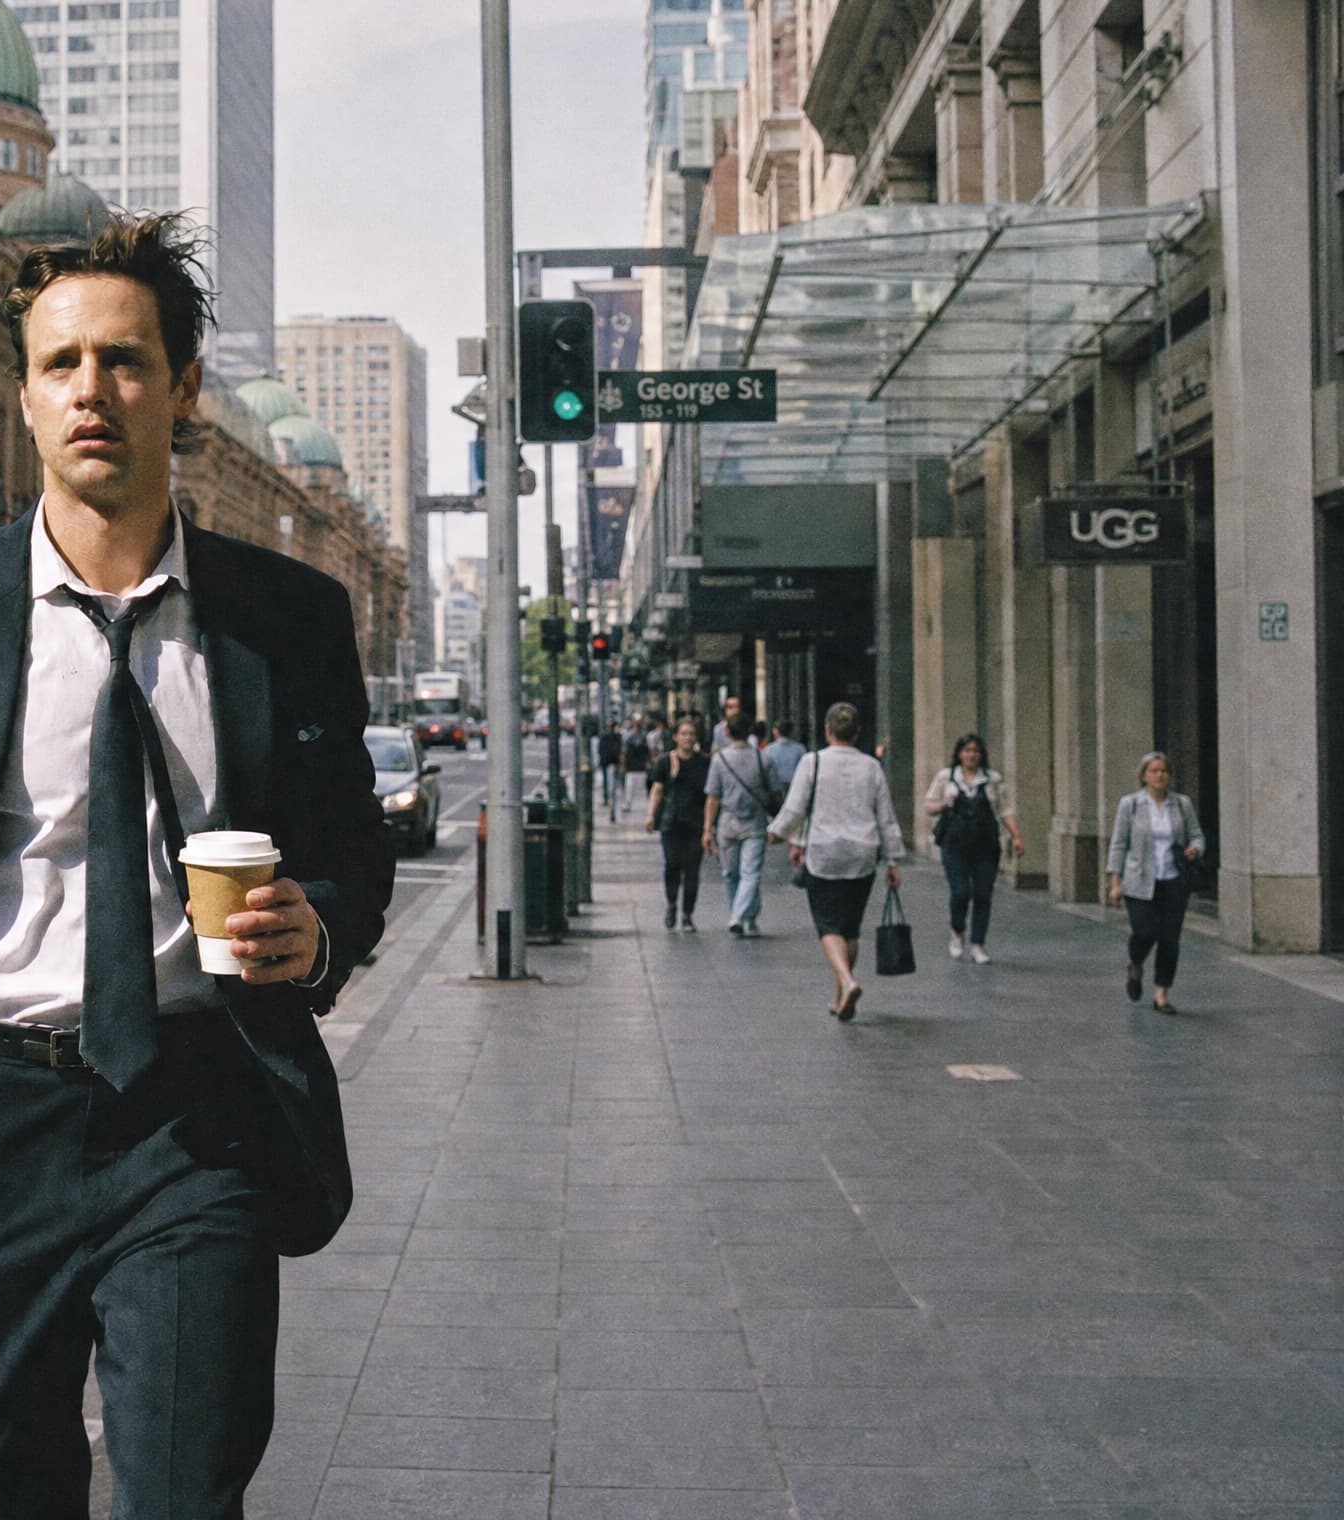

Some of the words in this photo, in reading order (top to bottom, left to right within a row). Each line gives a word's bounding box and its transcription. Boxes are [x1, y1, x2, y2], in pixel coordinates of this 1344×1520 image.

[637, 377, 730, 405] George
[737, 376, 764, 400] St
[639, 404, 663, 418] 153
[675, 404, 699, 418] 119
[1069, 508, 1159, 549] UGG
